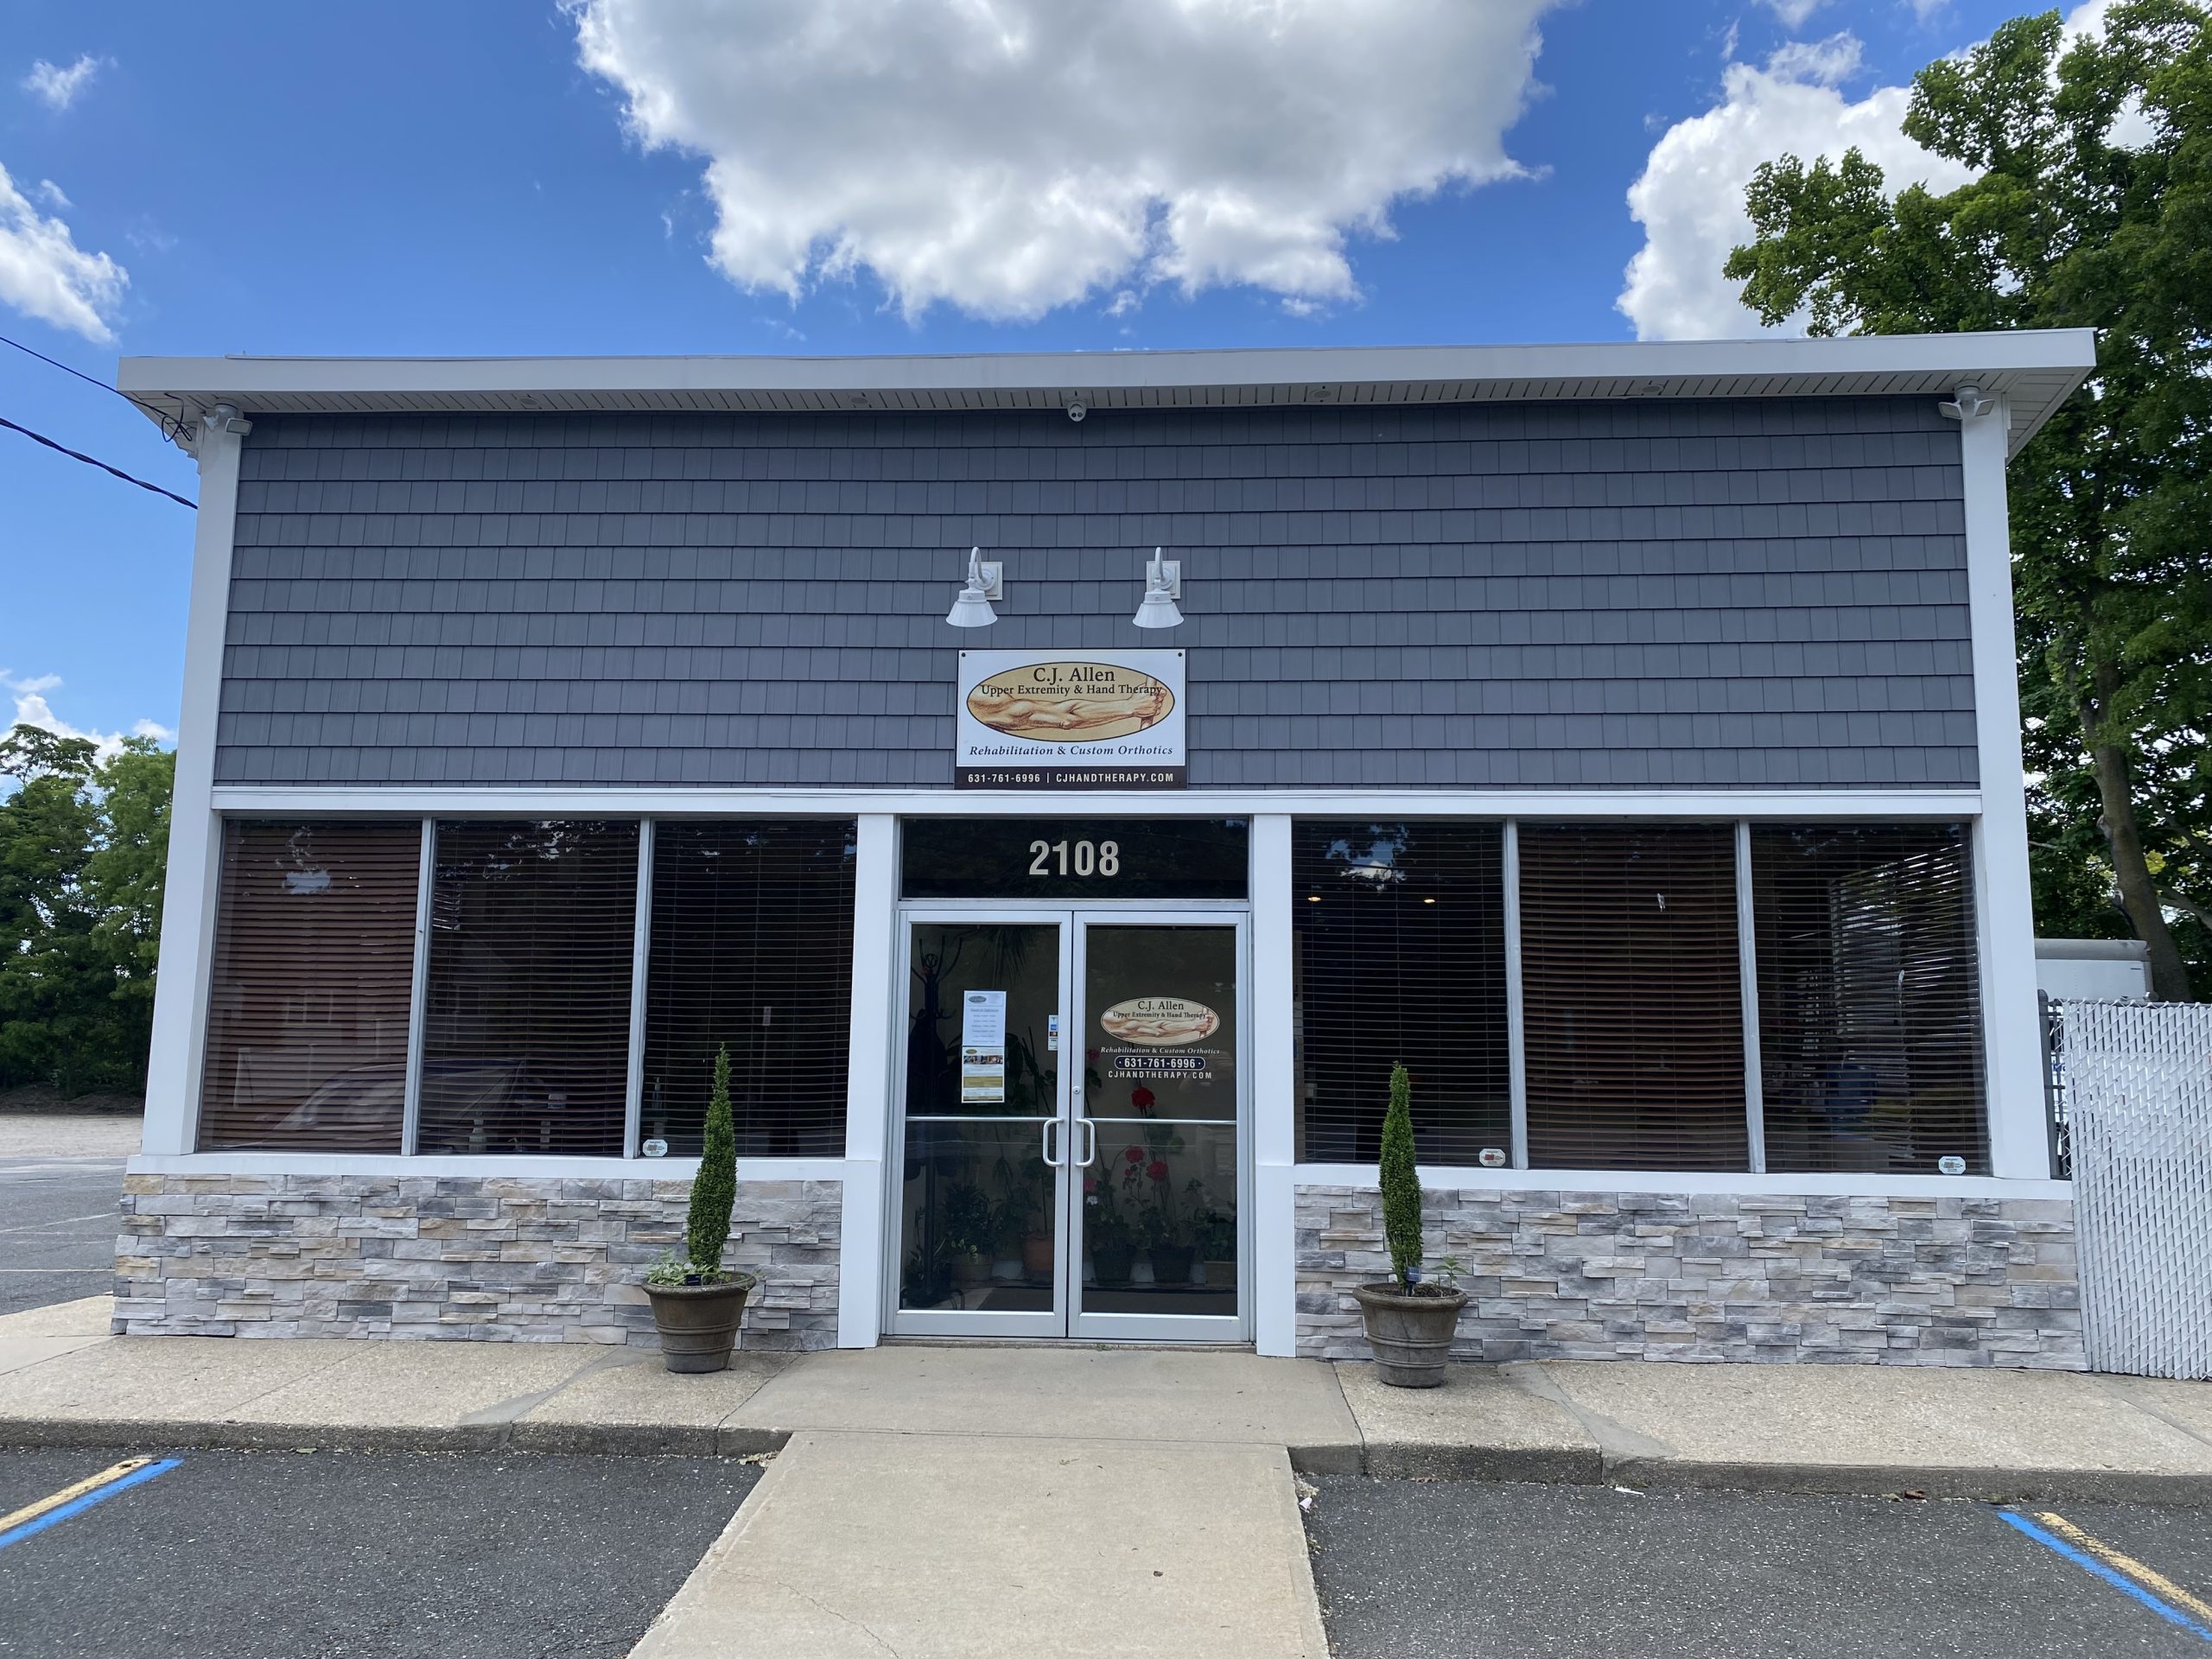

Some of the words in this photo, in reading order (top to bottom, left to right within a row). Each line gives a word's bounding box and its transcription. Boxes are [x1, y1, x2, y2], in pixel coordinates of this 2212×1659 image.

[1033, 667, 1063, 685] C.J.
[1068, 666, 1116, 683] Allen
[981, 684, 1014, 696] Upper
[1017, 684, 1069, 696] Extremity
[1072, 684, 1083, 695] &
[1086, 684, 1115, 695] Hand
[1118, 683, 1163, 696] Therapy
[969, 746, 1053, 756] Rehabilitation
[1057, 747, 1067, 756] &
[1070, 746, 1114, 756] Custom
[1117, 746, 1173, 756] Orthotics
[968, 773, 1040, 784] 631-761-6996
[1056, 772, 1174, 783] CJHANDTHERAPY.COM
[1028, 839, 1120, 877] 2108
[1137, 1001, 1155, 1012] C.J.
[1158, 1001, 1185, 1010] Allen
[1124, 1058, 1196, 1069] 631-761-6996
